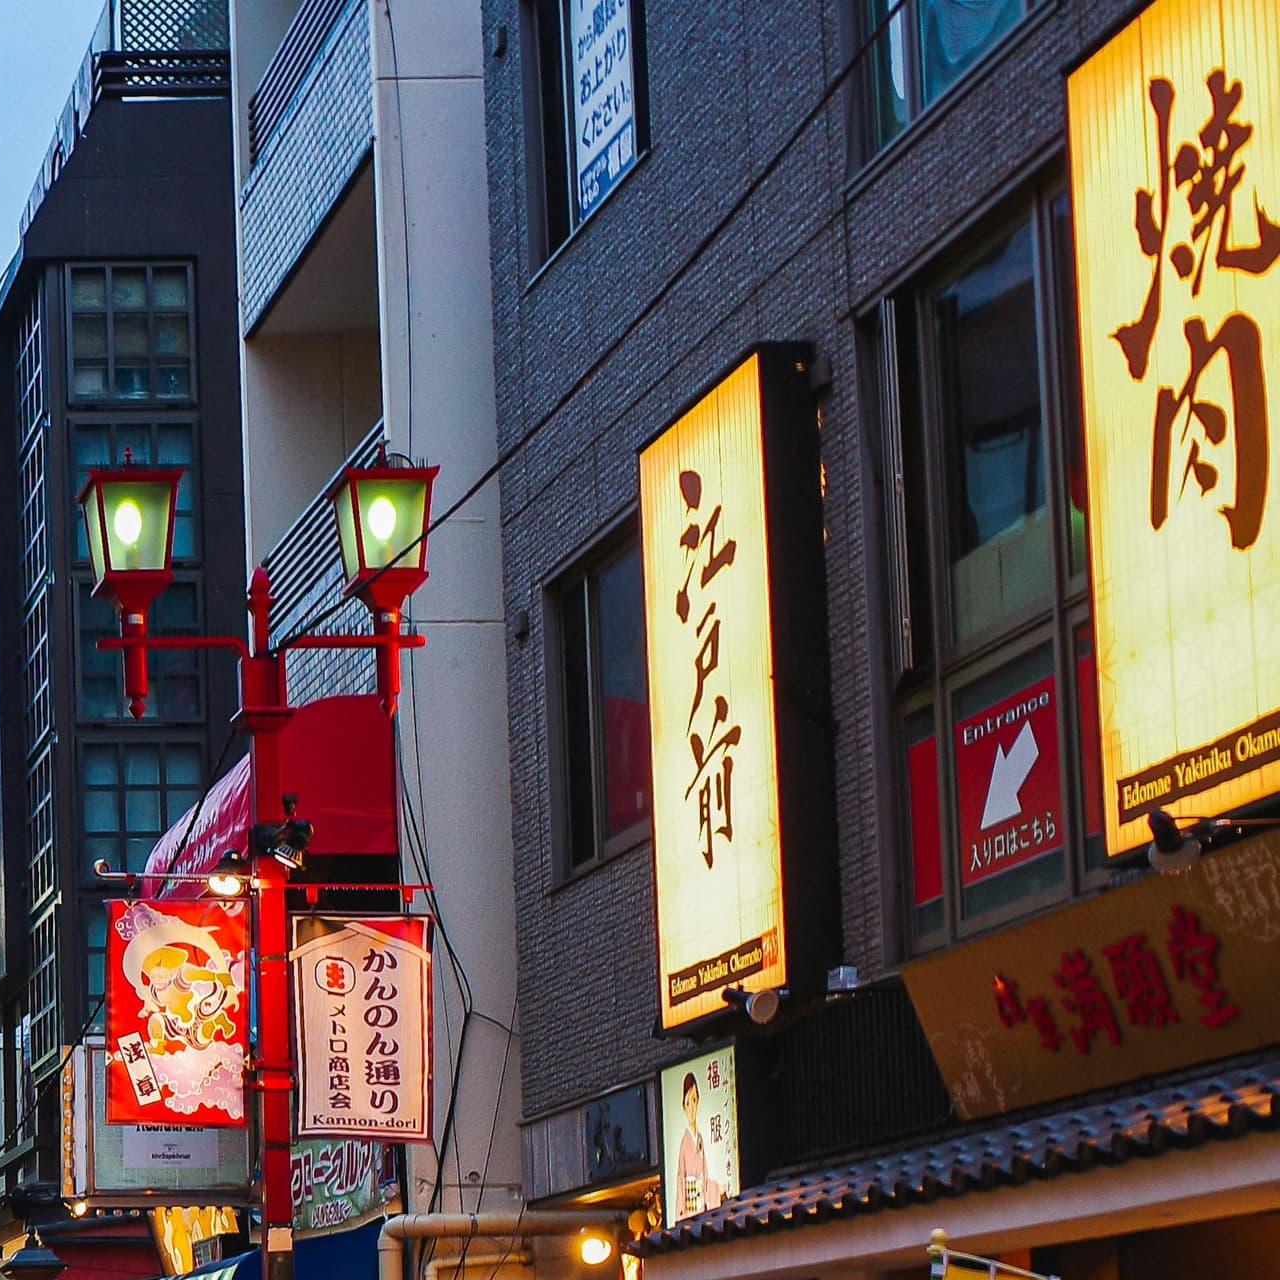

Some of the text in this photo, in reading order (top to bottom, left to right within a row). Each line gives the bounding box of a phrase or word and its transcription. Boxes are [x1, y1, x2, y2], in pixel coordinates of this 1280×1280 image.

[1109, 67, 1280, 552] 焼肉
[676, 470, 742, 869] 江戸前
[963, 692, 1050, 746] Entrance
[1123, 774, 1172, 811] Edomae
[1175, 746, 1233, 788] Yakiniku
[970, 811, 1056, 872] 入り口はこちら
[671, 948, 763, 998] Edomae Yakiniku Okamoto
[328, 1004, 351, 1110] メトロ商店会
[363, 948, 401, 1115] かんのん通り
[123, 1041, 157, 1098] 浅草
[312, 1114, 417, 1130] Kannon-dori
[707, 1060, 724, 1145] 福服
